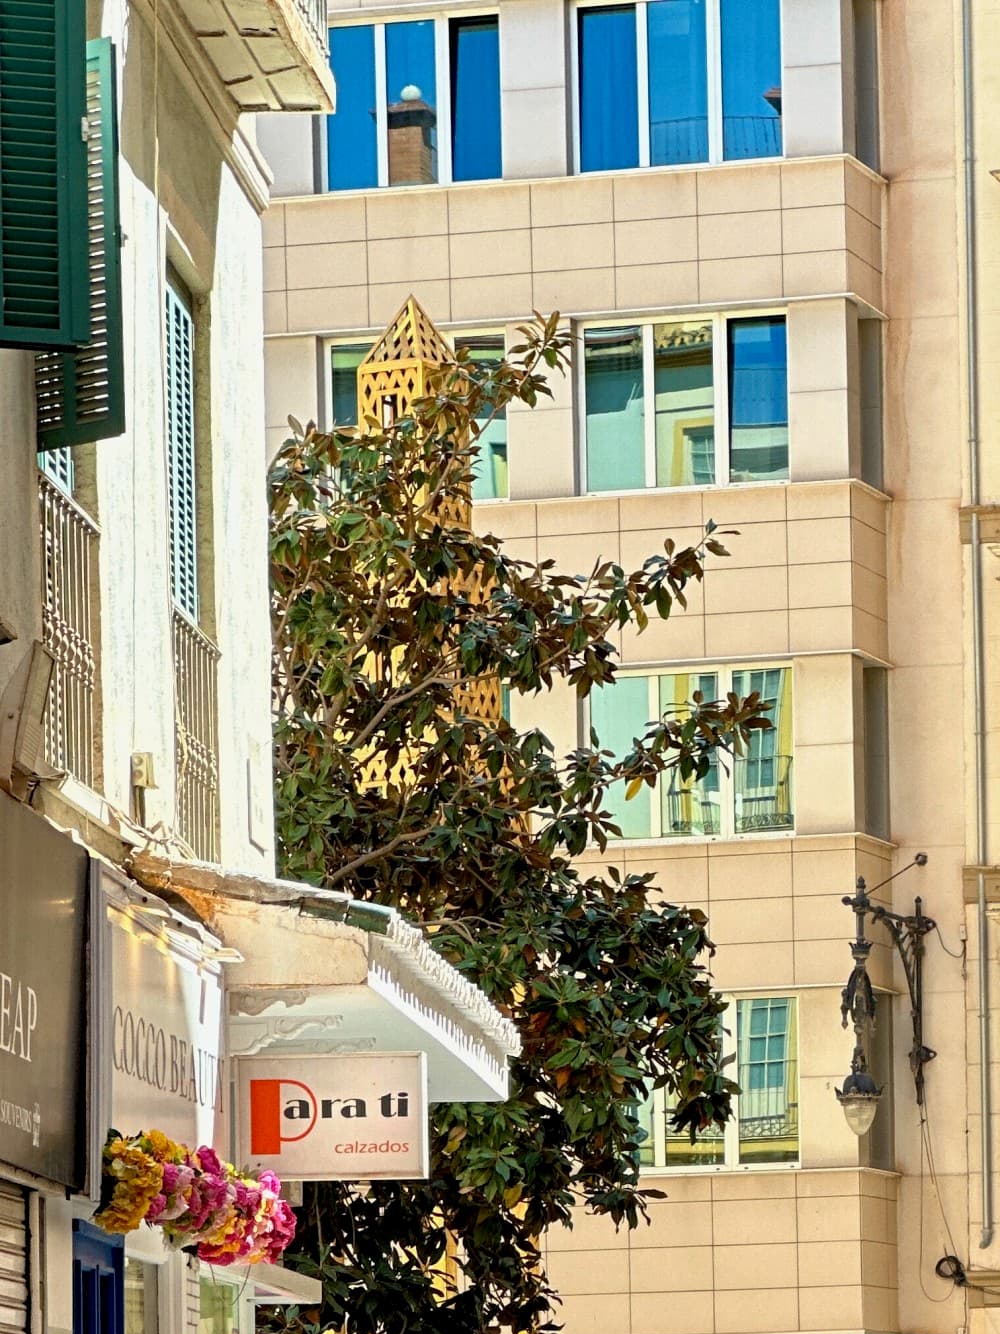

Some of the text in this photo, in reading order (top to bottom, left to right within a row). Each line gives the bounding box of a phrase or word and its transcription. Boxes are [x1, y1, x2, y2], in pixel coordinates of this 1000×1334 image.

[250, 1079, 409, 1155] Para ti
[334, 1140, 409, 1154] calzados
